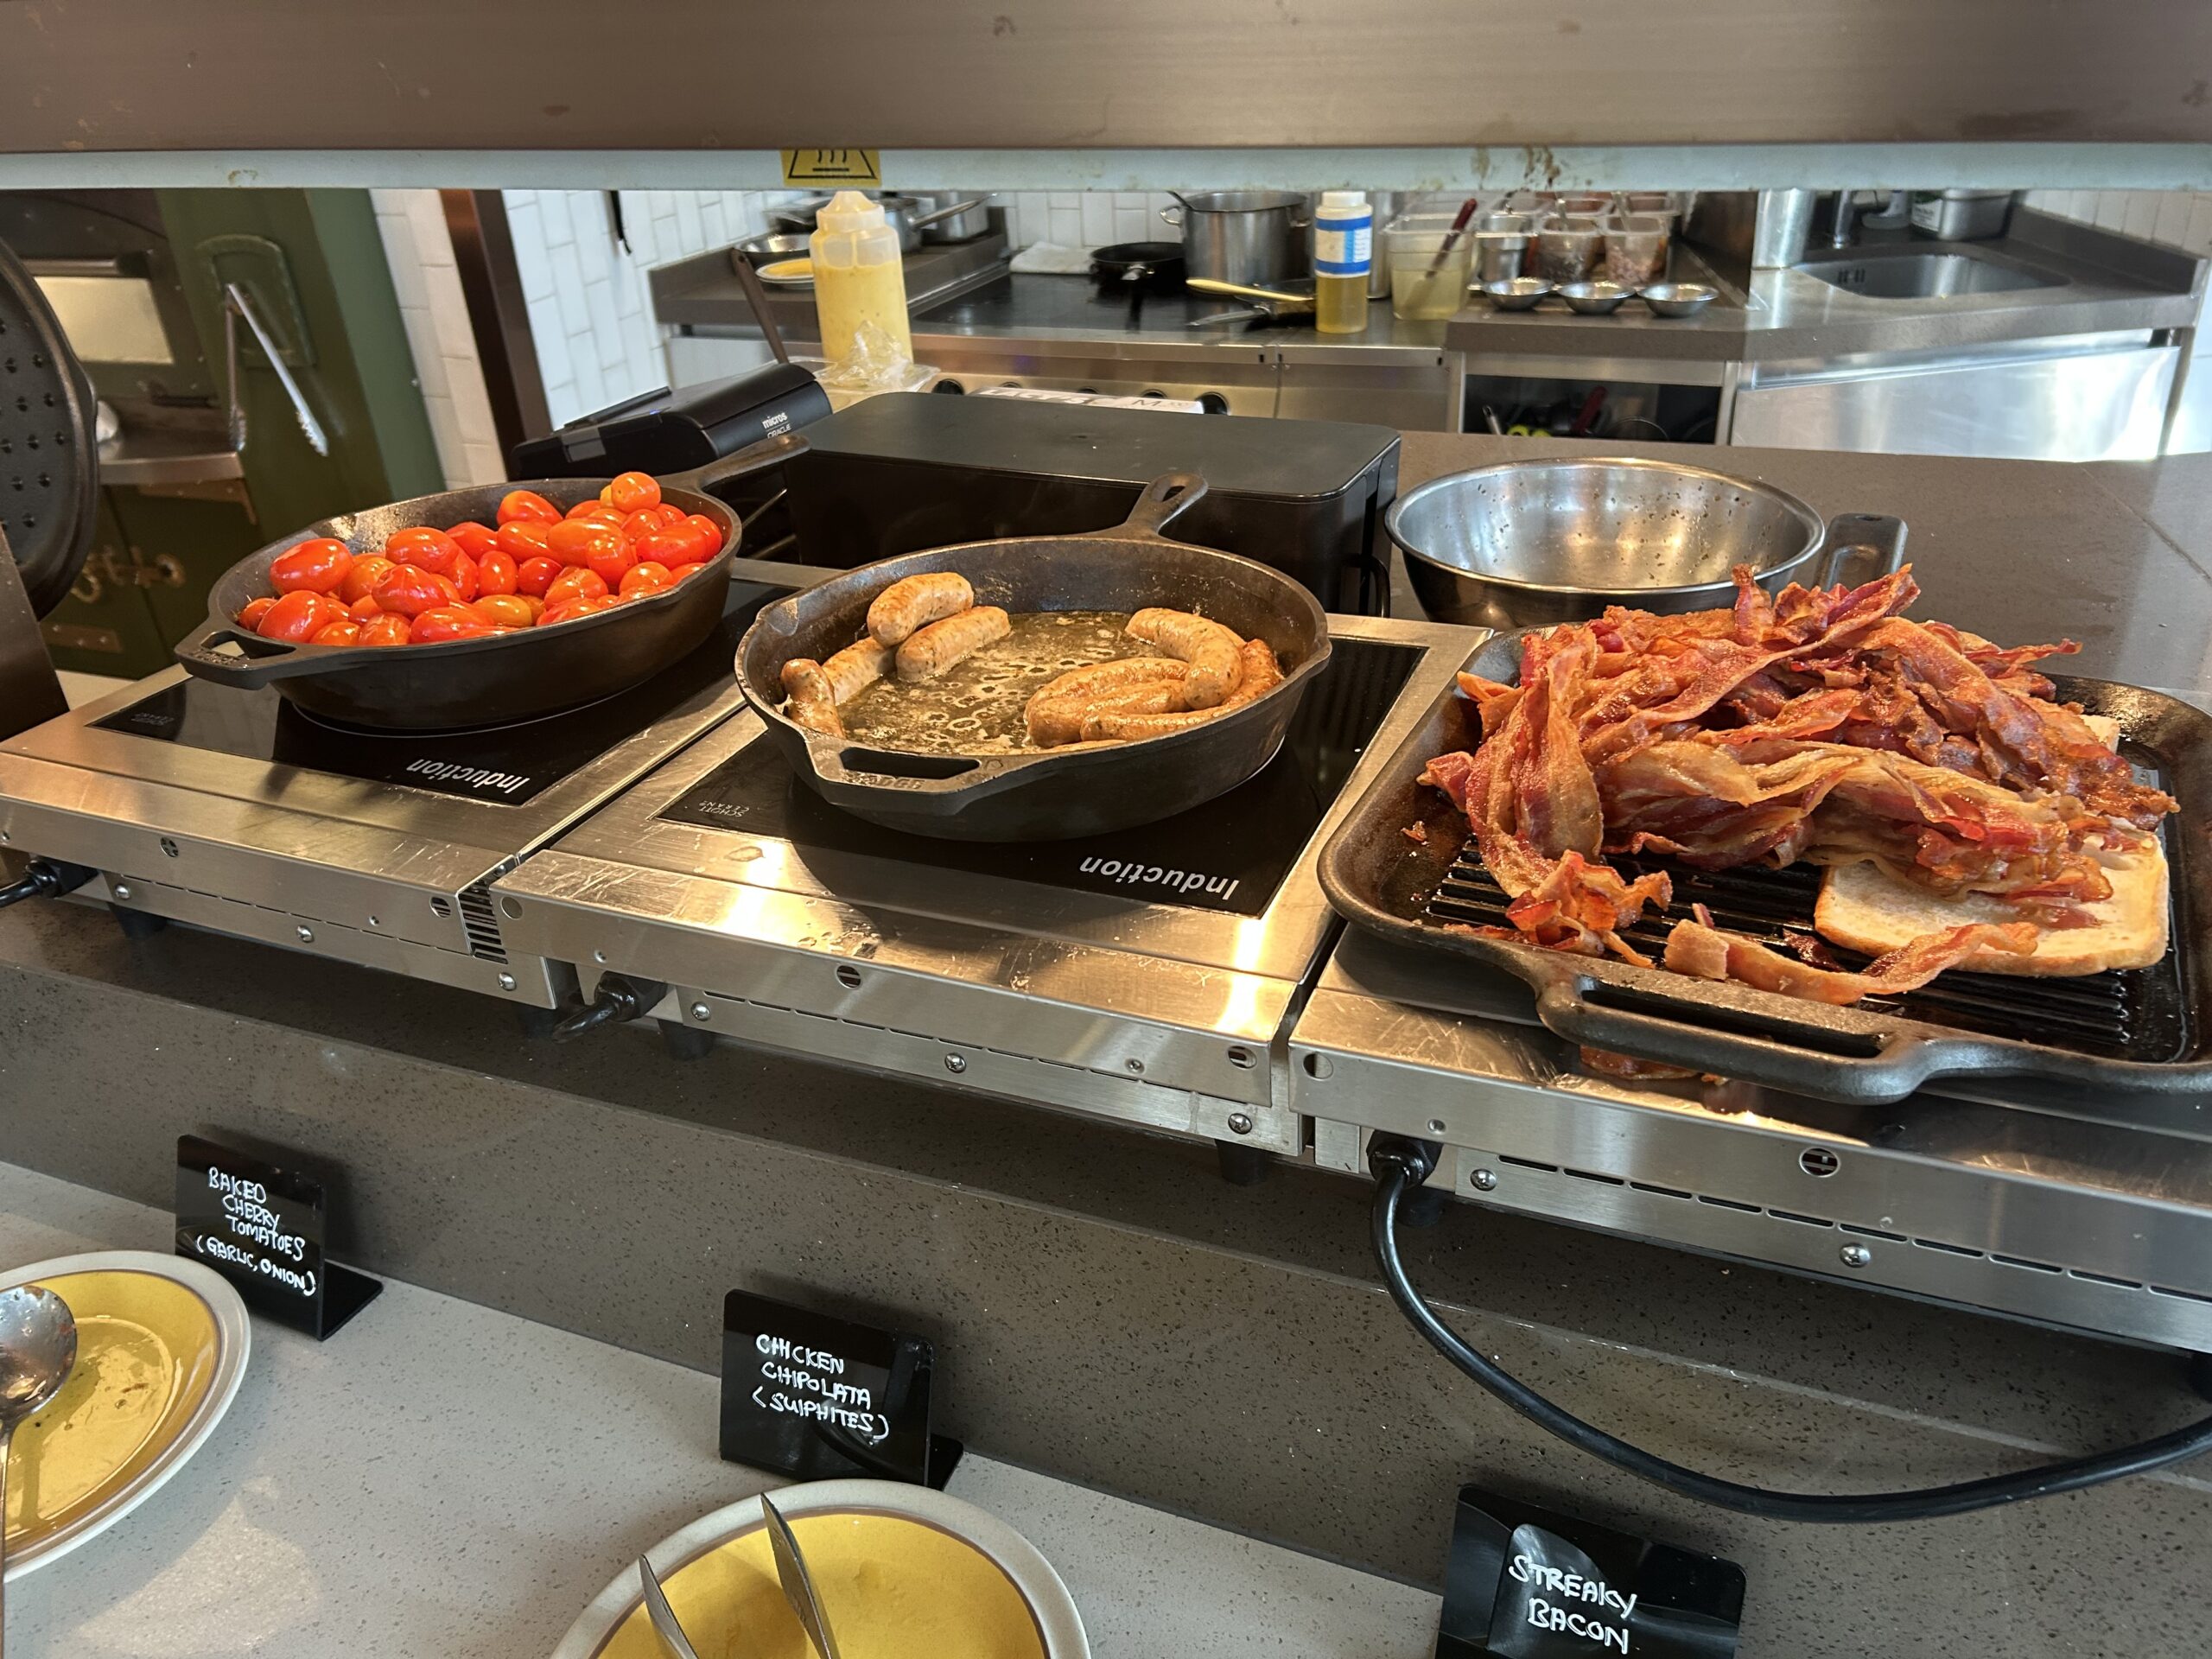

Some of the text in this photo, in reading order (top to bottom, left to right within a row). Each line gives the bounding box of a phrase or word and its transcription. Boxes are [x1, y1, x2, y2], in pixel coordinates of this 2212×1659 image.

[762, 412, 788, 429] micros
[406, 759, 531, 794] Induction
[1079, 856, 1240, 900] Induction
[208, 1166, 267, 1204] BAKED
[222, 1193, 281, 1231] CHERRY
[225, 1214, 306, 1262] TOMATOES
[755, 1333, 844, 1375] CHICKEN
[760, 1361, 872, 1410] CHIPOLATA
[1509, 1554, 1637, 1620] STREAKY
[1527, 1598, 1629, 1655] BACON
